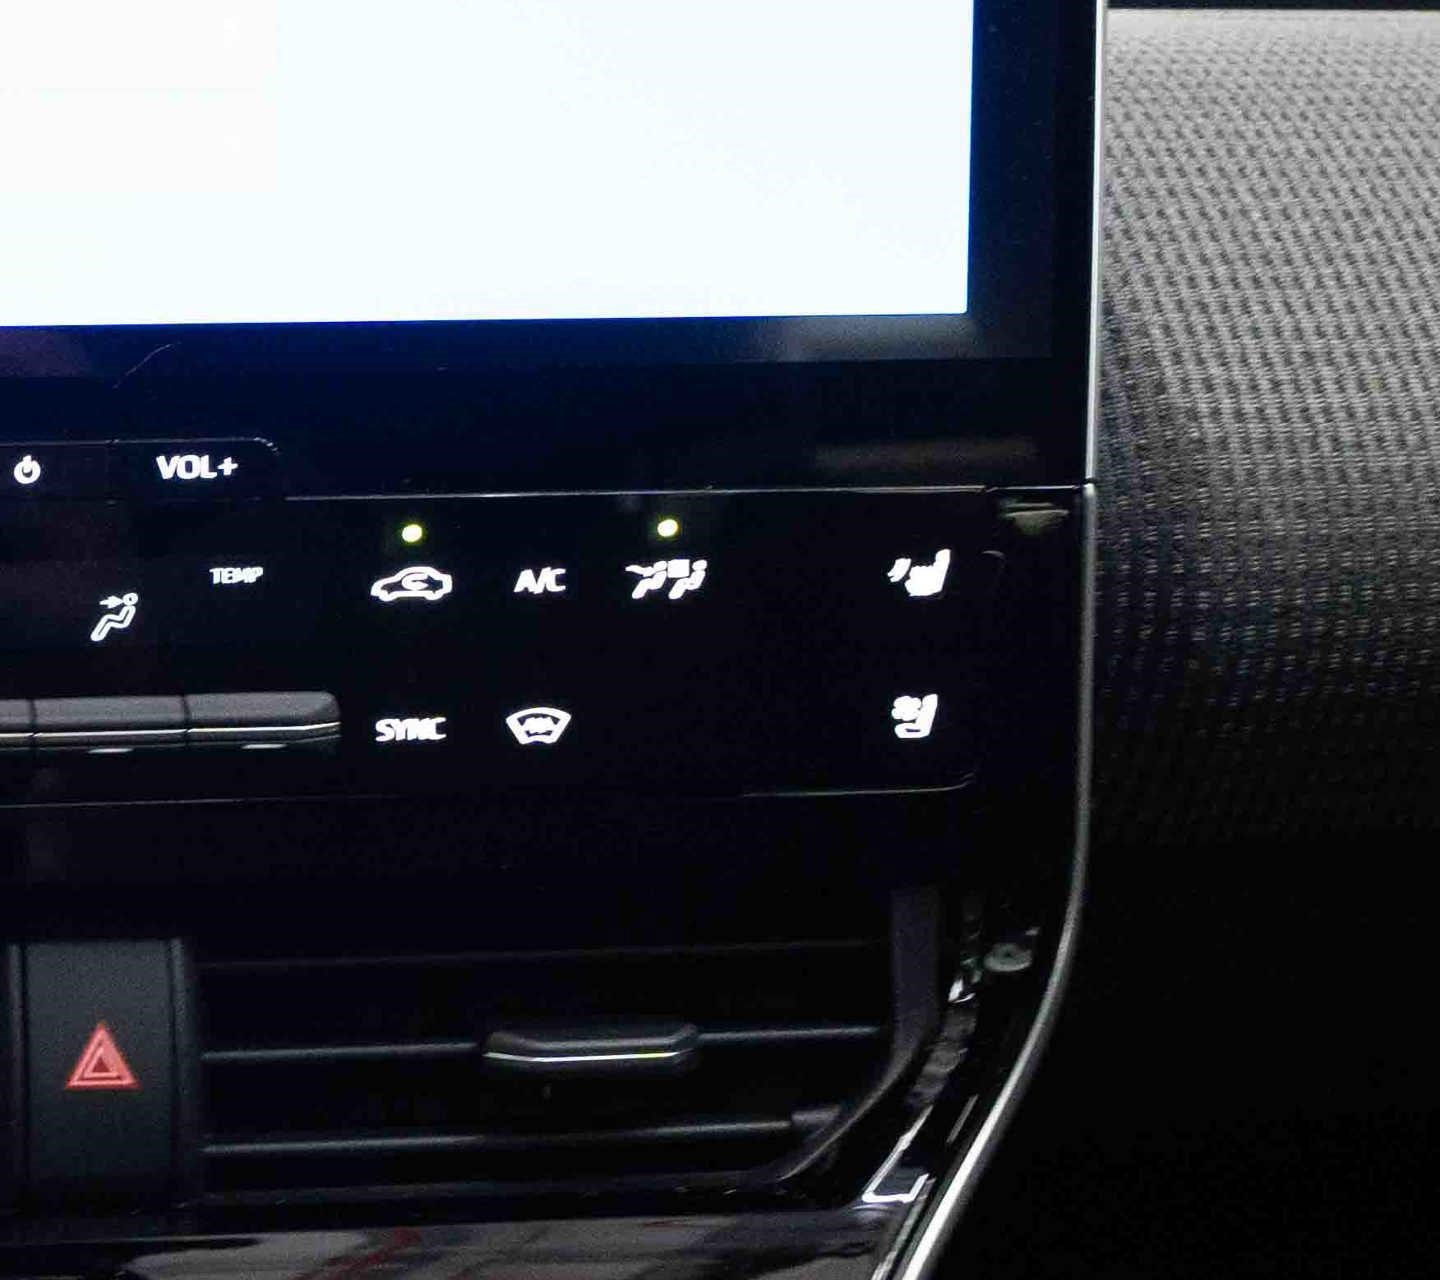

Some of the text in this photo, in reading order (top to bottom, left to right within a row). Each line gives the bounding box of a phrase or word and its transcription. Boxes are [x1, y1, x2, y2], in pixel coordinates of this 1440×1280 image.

[156, 455, 238, 479] VOL+
[209, 567, 263, 584] TEMP
[514, 567, 566, 594] A/C
[376, 717, 446, 741] SYNC
